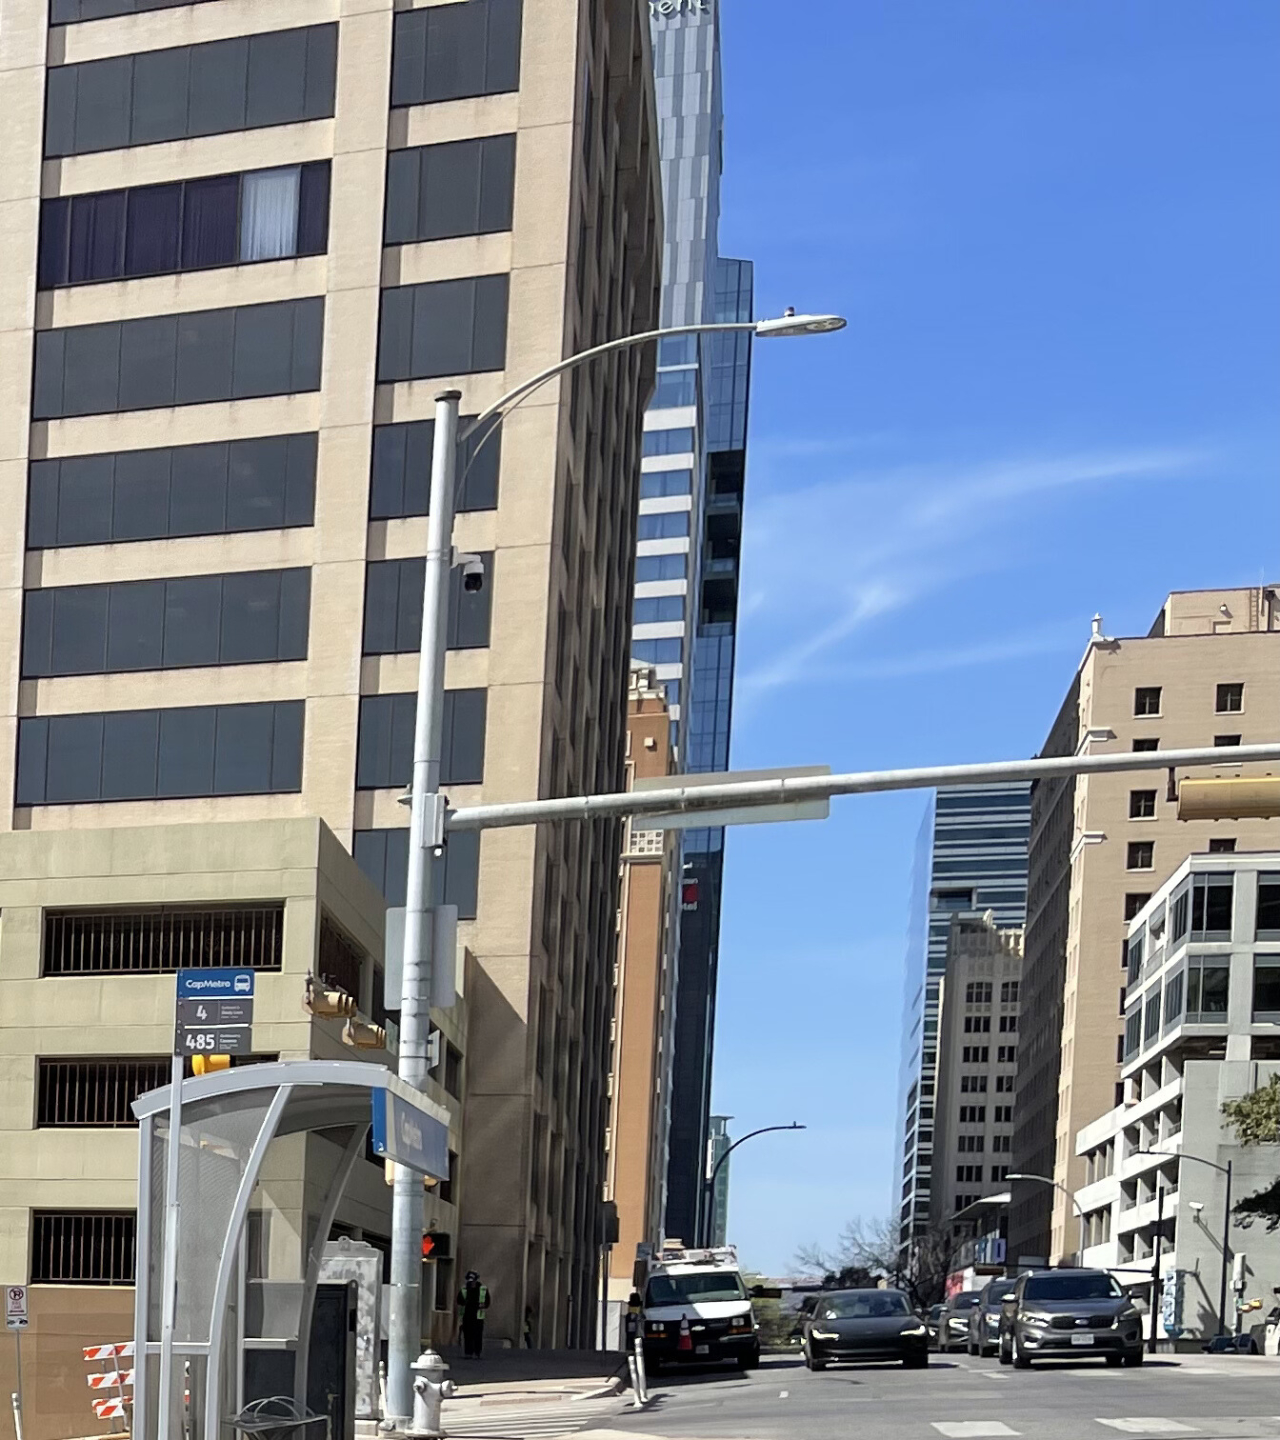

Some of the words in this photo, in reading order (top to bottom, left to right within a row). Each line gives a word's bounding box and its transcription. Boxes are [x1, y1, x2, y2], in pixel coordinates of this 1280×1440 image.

[186, 980, 231, 989] CapMetro
[196, 1005, 207, 1020] 4
[186, 1034, 215, 1049] 485
